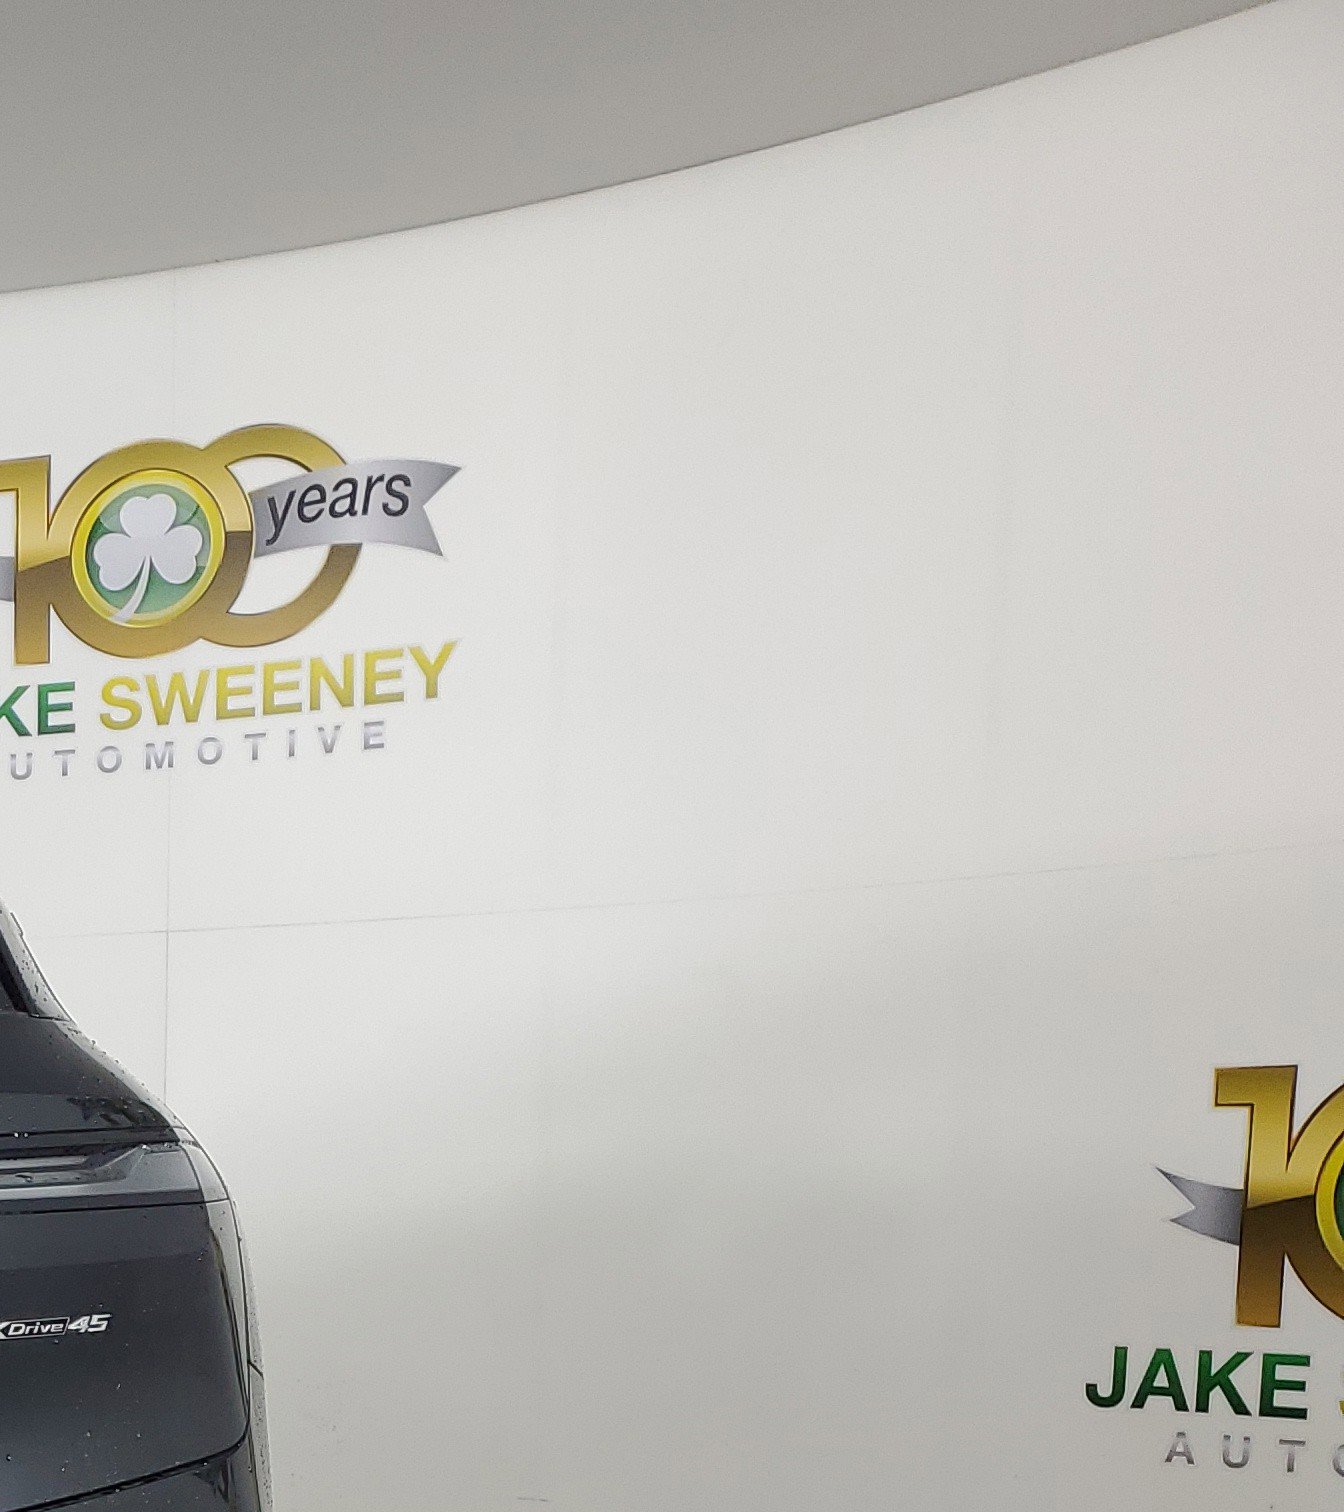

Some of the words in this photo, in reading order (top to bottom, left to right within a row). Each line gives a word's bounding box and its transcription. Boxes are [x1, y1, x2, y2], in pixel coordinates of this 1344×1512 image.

[266, 472, 412, 545] years
[99, 641, 458, 731] SWEENEY
[1085, 1345, 1311, 1420] JAKE
